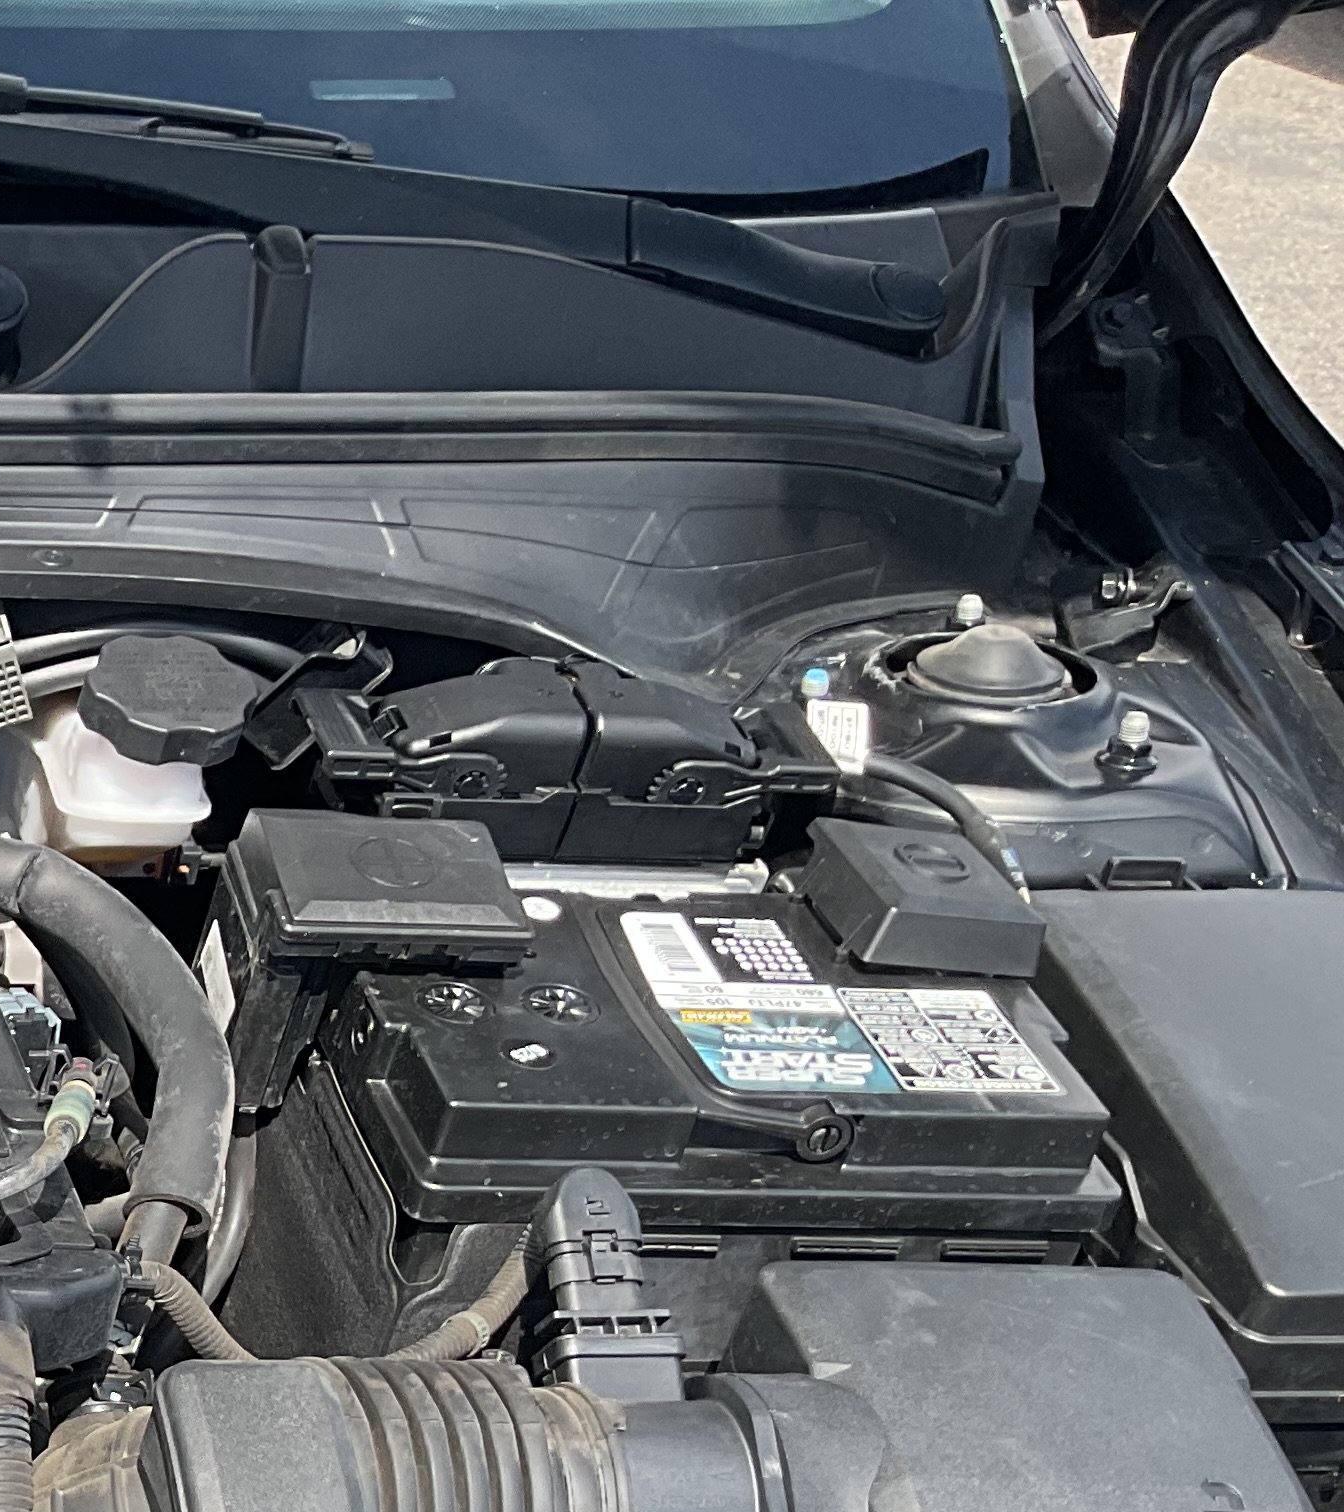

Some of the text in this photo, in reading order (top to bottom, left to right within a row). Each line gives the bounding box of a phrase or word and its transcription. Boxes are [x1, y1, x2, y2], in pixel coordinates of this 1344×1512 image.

[706, 997, 733, 1007] 105
[748, 997, 802, 1009] 47PLTJ
[724, 1032, 838, 1045] PLATINUM
[717, 1051, 874, 1074] START
[726, 1066, 866, 1086] SUPER
